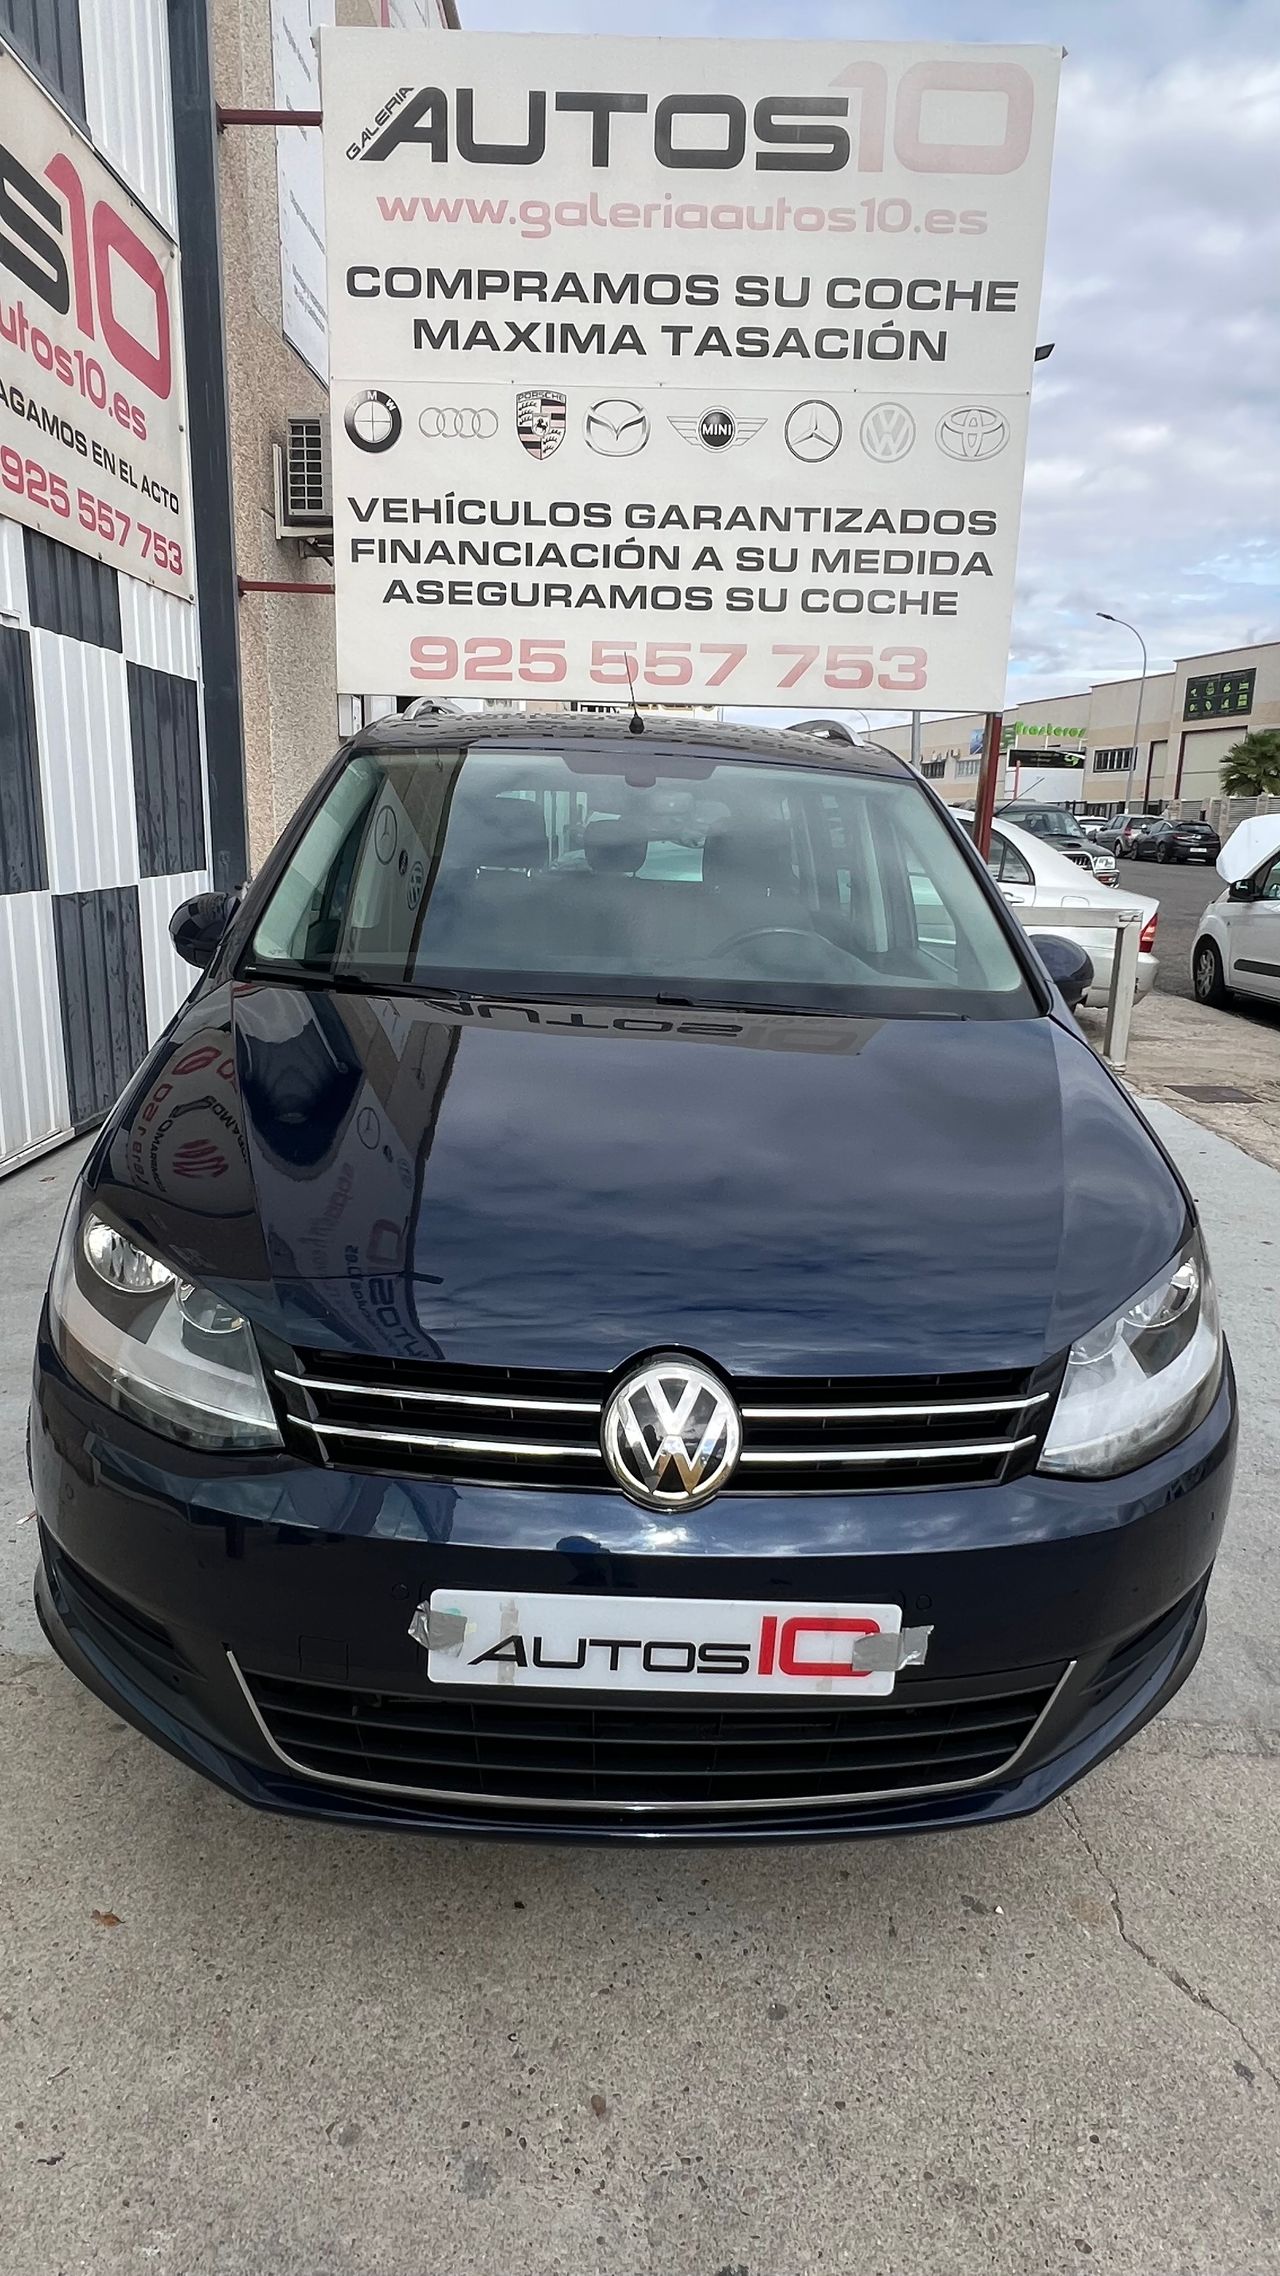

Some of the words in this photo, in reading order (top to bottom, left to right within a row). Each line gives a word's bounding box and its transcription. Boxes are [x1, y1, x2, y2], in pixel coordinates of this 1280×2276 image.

[345, 87, 415, 161] GALERIA
[360, 62, 1034, 175] AUTOS10
[376, 191, 989, 239] www.galeriaautos10.es
[346, 266, 720, 307] COMPRAMOS
[735, 276, 811, 310] SU
[827, 278, 1020, 313] COCHE
[413, 319, 648, 357] MAXIMA
[661, 321, 948, 363] TASACIÓN
[702, 423, 732, 436] MINI
[92, 440, 116, 476] EN
[119, 460, 138, 490] EL
[141, 475, 180, 515] ACTO
[1, 444, 70, 519] 925
[77, 487, 132, 547] 557
[137, 521, 184, 577] 753
[348, 492, 612, 530] VEHÍCULOS
[624, 504, 997, 537] GARANTIZADOS
[350, 537, 680, 571] FINANCIACIÓN
[691, 547, 725, 573] A
[736, 547, 799, 574] SU
[812, 549, 994, 578] MEDIDA
[382, 579, 714, 613] ASEGURAMOS
[726, 586, 788, 614] SU
[801, 588, 959, 617] COCHE
[409, 636, 568, 684] 925
[589, 640, 748, 689] 557
[773, 645, 928, 692] 753
[468, 1616, 880, 1677] AUTOS10
